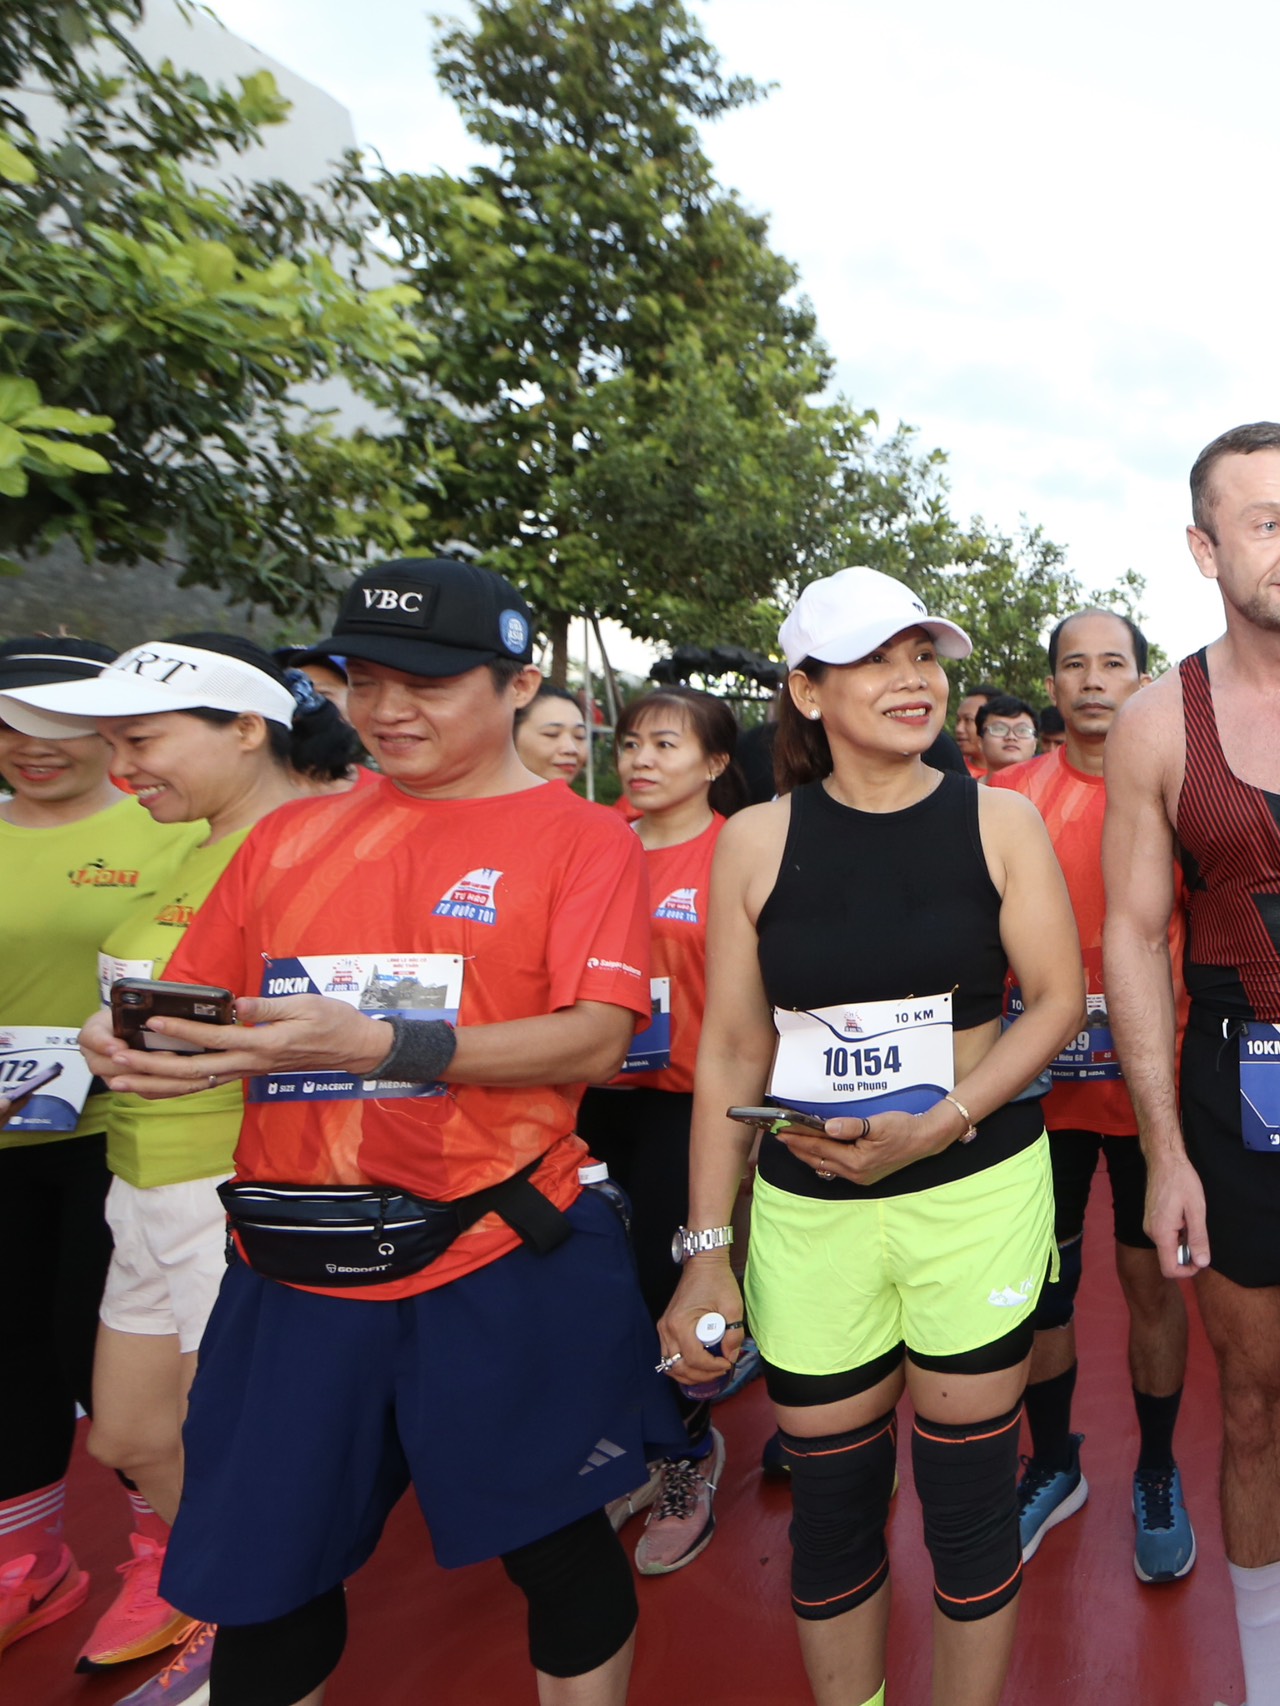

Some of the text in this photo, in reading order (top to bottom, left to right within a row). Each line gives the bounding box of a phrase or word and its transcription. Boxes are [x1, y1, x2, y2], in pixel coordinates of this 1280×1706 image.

[362, 588, 424, 613] VBC
[268, 977, 310, 995] 10KM
[895, 1009, 934, 1024] 10 KM
[823, 1045, 902, 1078] 10154
[279, 1084, 295, 1093] SIZE
[315, 1082, 354, 1092] RACEKIT
[832, 1081, 888, 1092] Long Phung
